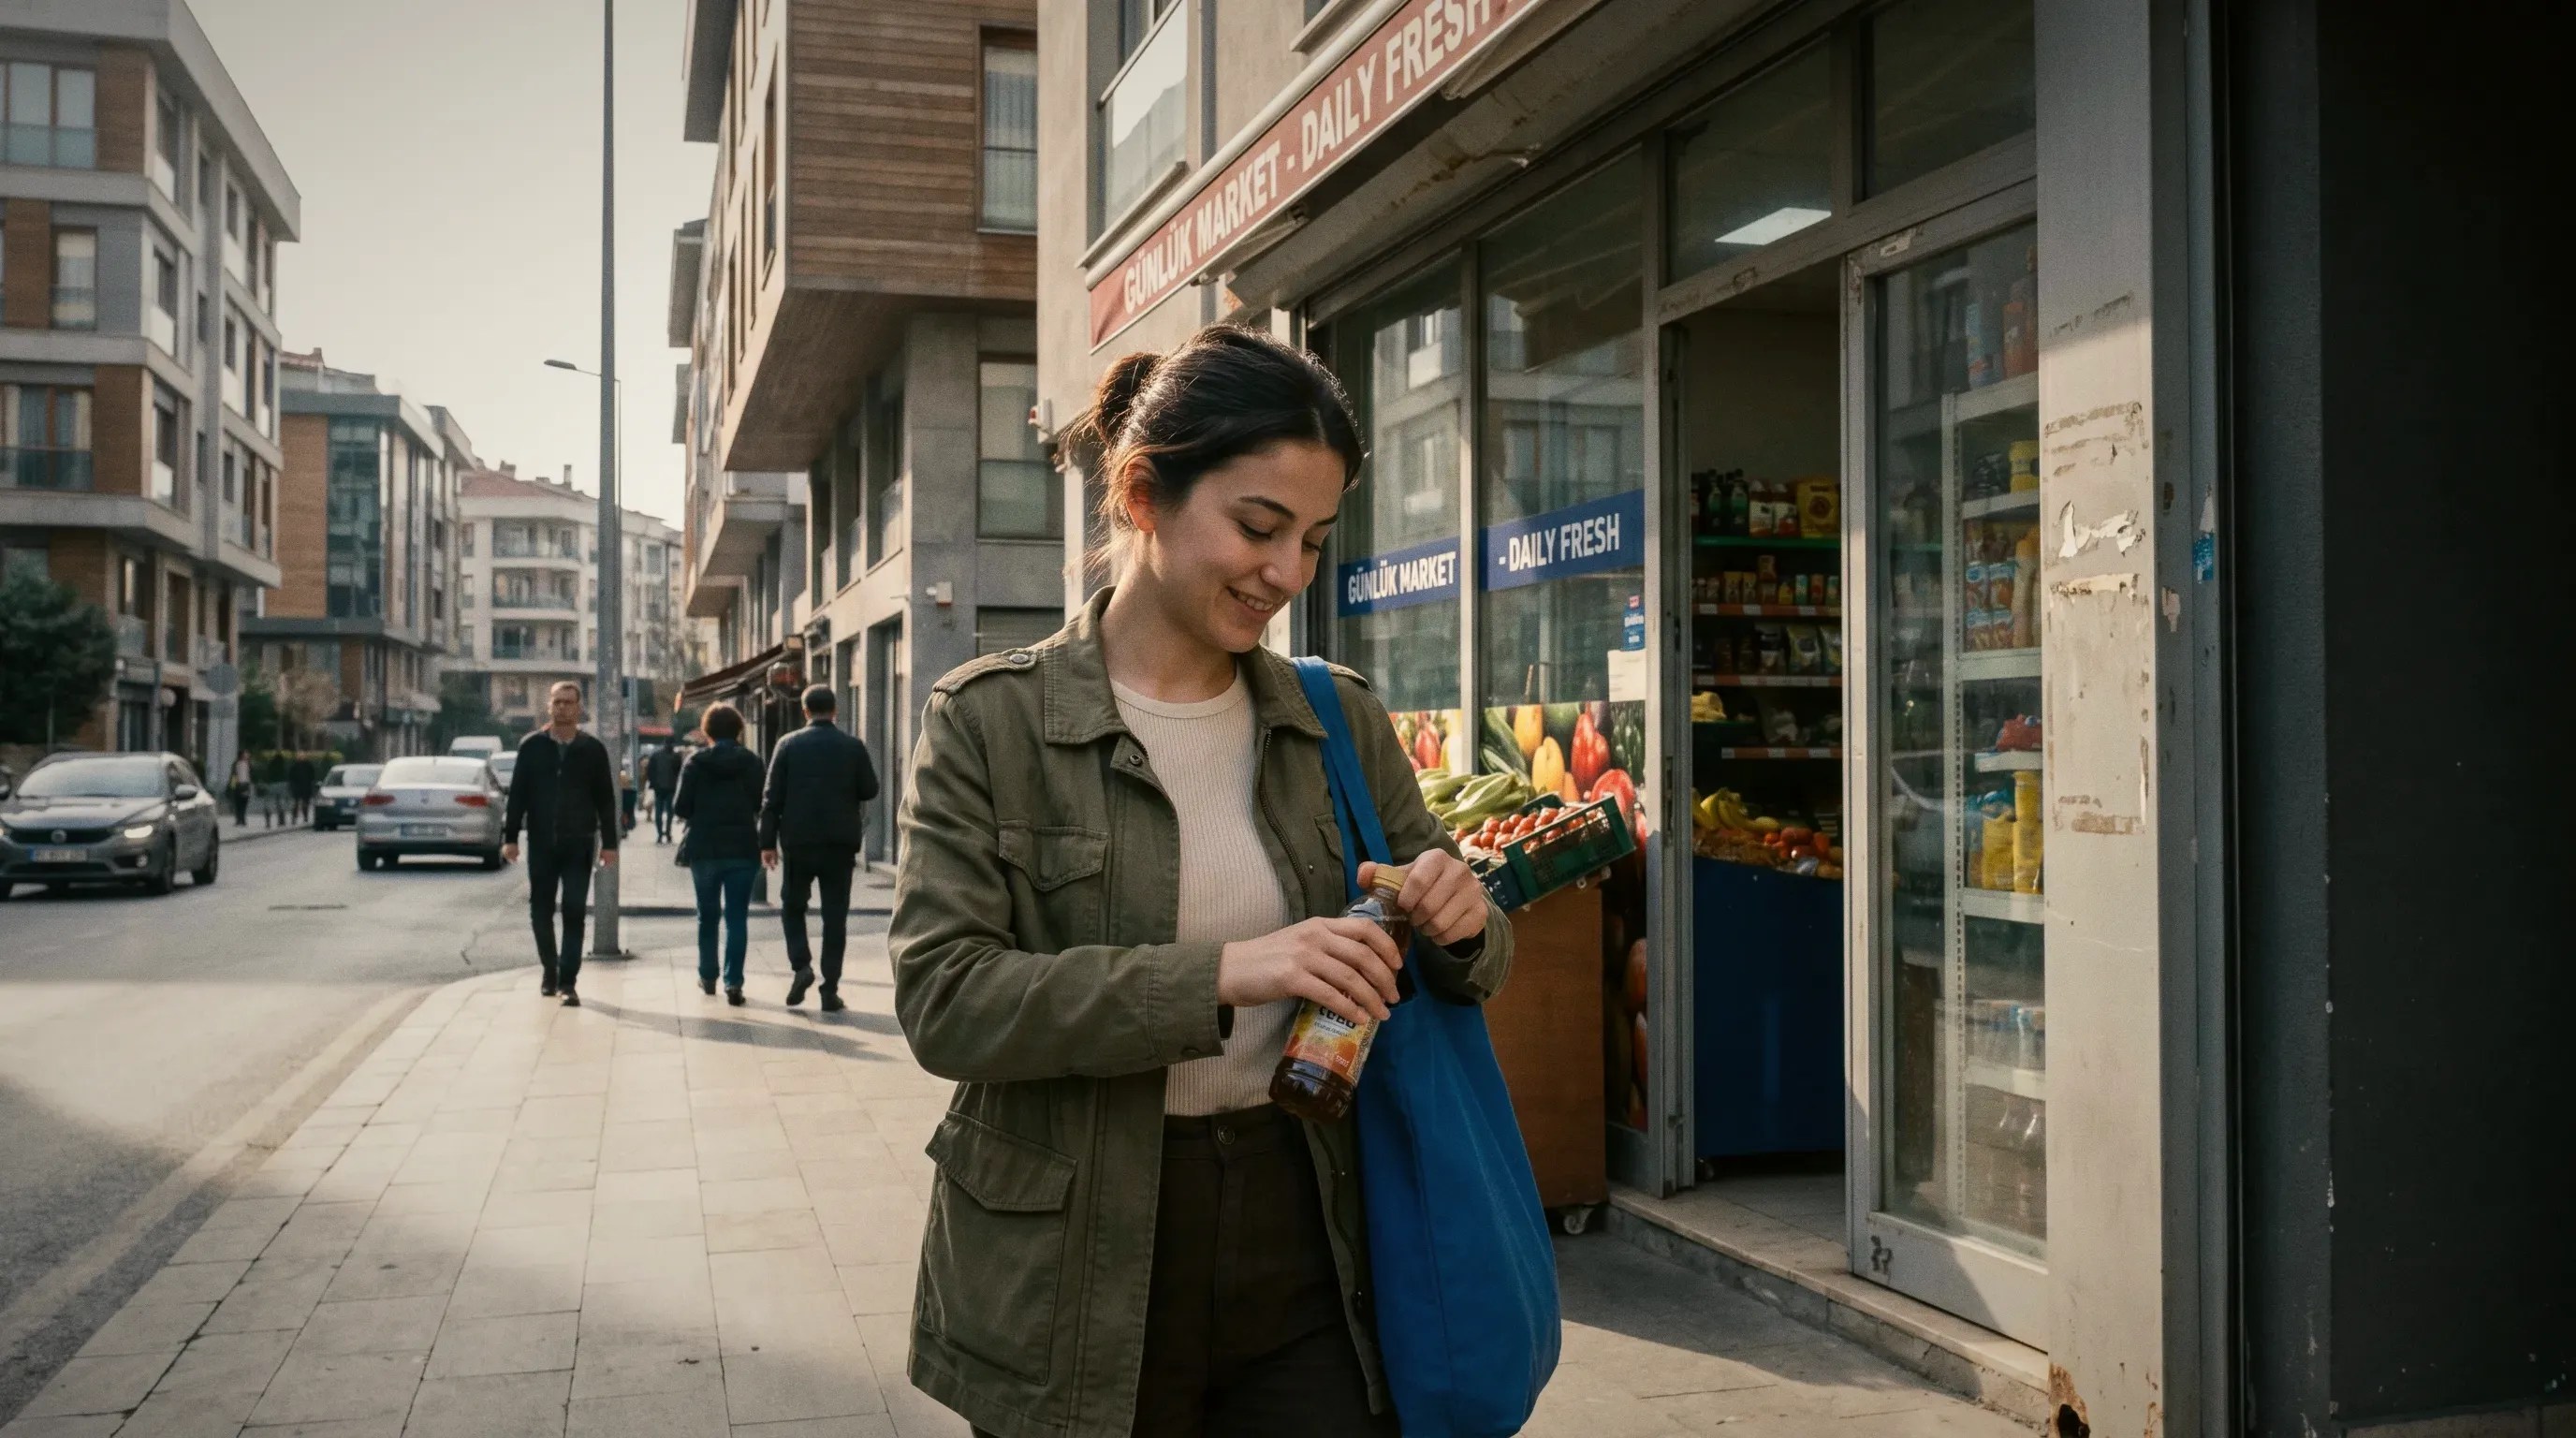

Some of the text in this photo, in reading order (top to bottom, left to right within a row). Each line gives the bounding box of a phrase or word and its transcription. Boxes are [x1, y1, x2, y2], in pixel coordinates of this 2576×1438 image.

[1124, 217, 1193, 315] GÜNLÜK
[1196, 140, 1281, 257] MARKET
[1287, 157, 1295, 170] -
[1301, 52, 1379, 173] DAILY
[1348, 557, 1398, 605] GÜNLÜK
[1399, 551, 1456, 595] MARKET
[1509, 528, 1557, 572] DAILY
[1560, 513, 1620, 562] FRESH
